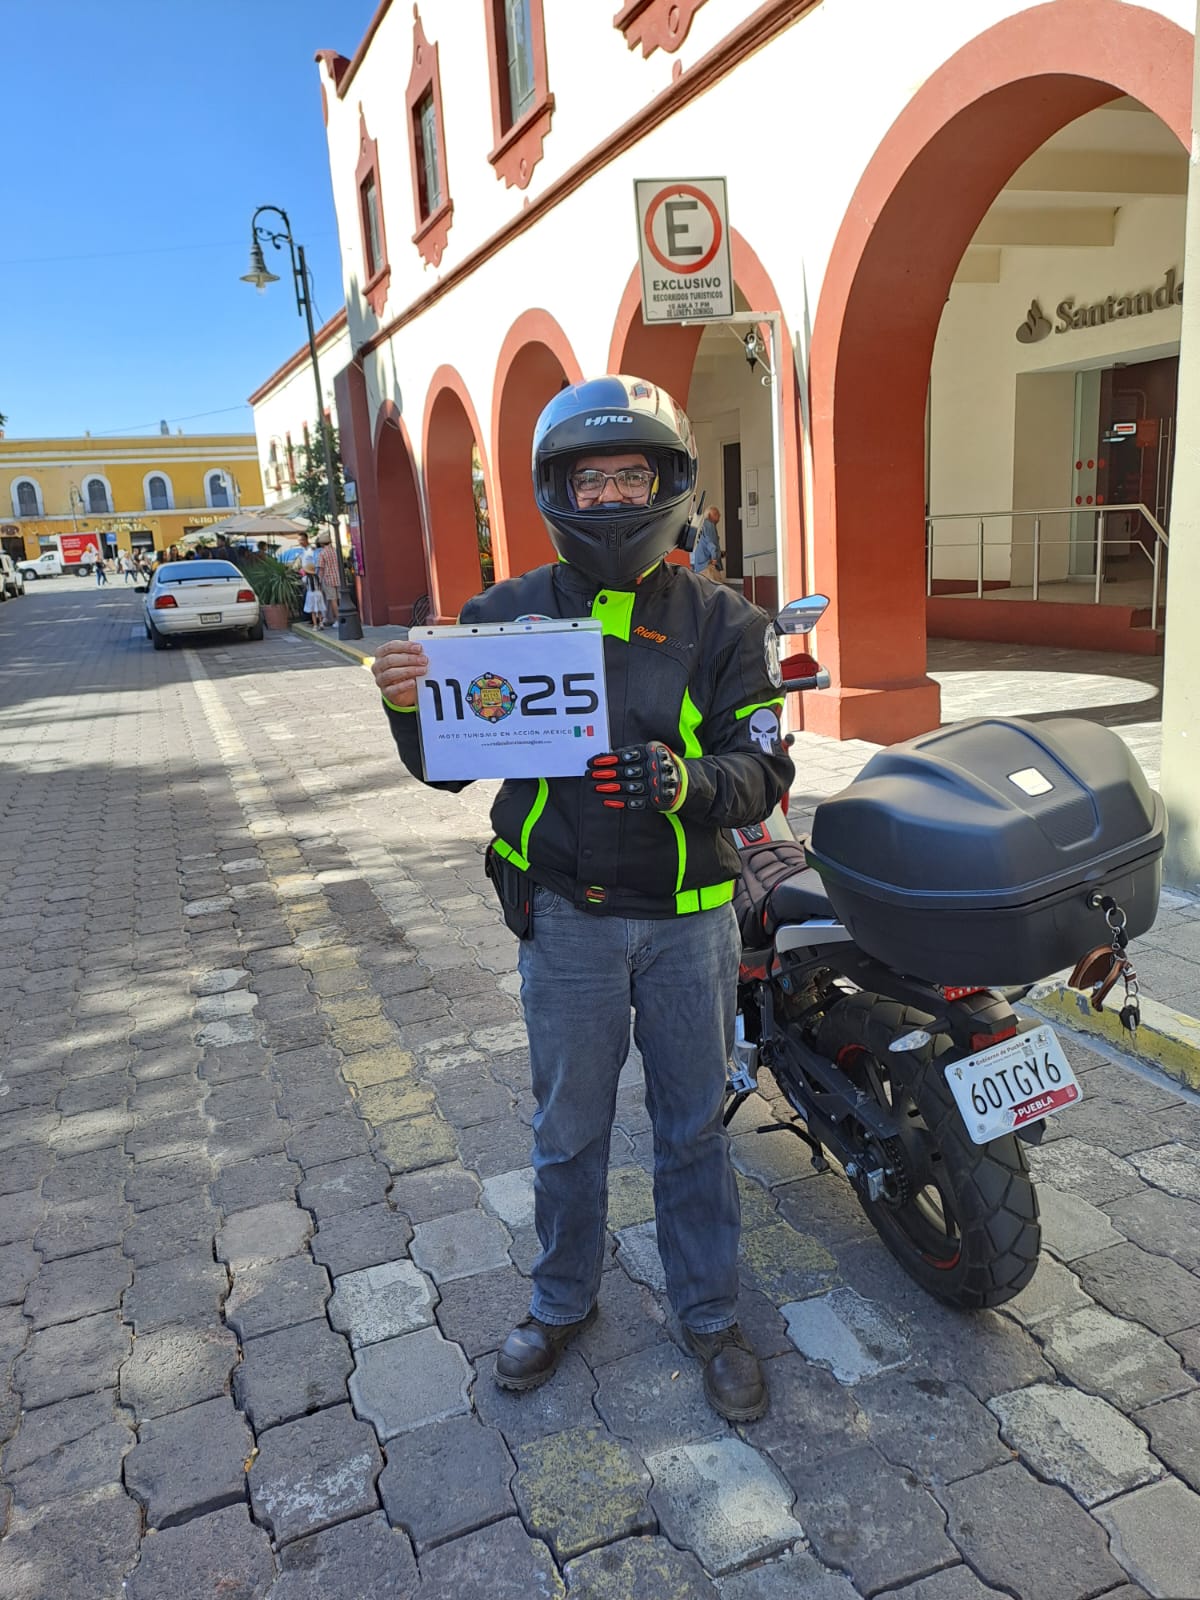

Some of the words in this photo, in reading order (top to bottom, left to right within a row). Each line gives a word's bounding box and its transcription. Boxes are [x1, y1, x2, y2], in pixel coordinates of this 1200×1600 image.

[665, 201, 703, 257] E
[653, 277, 721, 291] EXCLUSIVO
[653, 292, 688, 302] RECORRIDOS
[1055, 268, 1184, 334] Santande
[633, 625, 667, 644] Riding
[975, 1052, 1000, 1066] Gobierno
[1006, 1041, 1025, 1053] Puebla
[971, 1052, 1061, 1115] 60TGY6
[1018, 1096, 1054, 1118] PUEBLA
